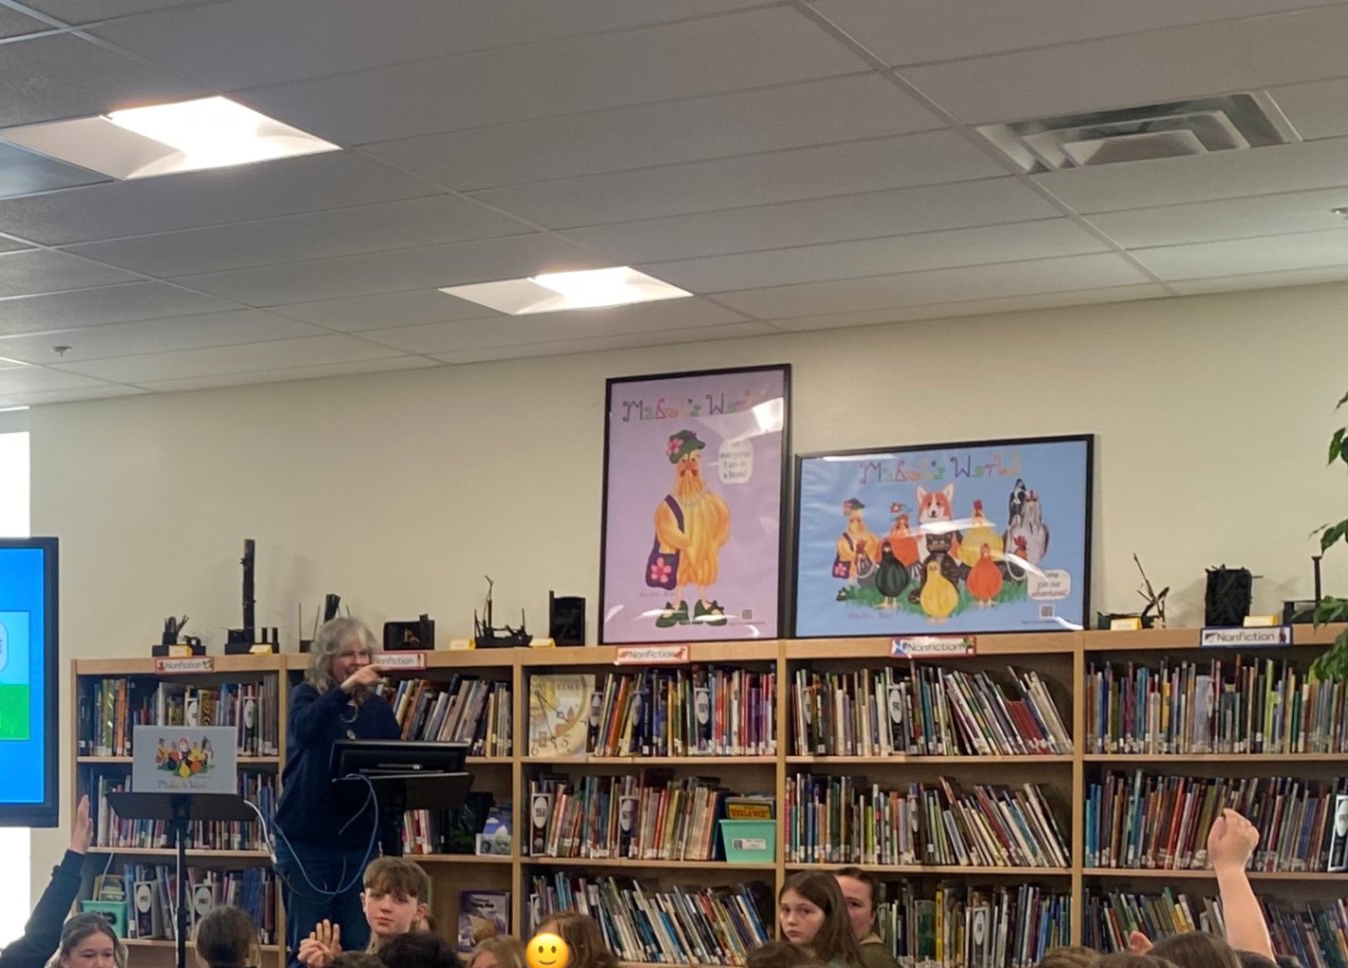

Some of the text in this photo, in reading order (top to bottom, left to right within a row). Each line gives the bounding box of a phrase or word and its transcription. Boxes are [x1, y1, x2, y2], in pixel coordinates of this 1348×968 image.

[1216, 631, 1275, 643] Nonfiction
[908, 640, 963, 652] Nonfiction
[629, 649, 673, 659] Nonfiction
[165, 660, 202, 671] Nonfiction
